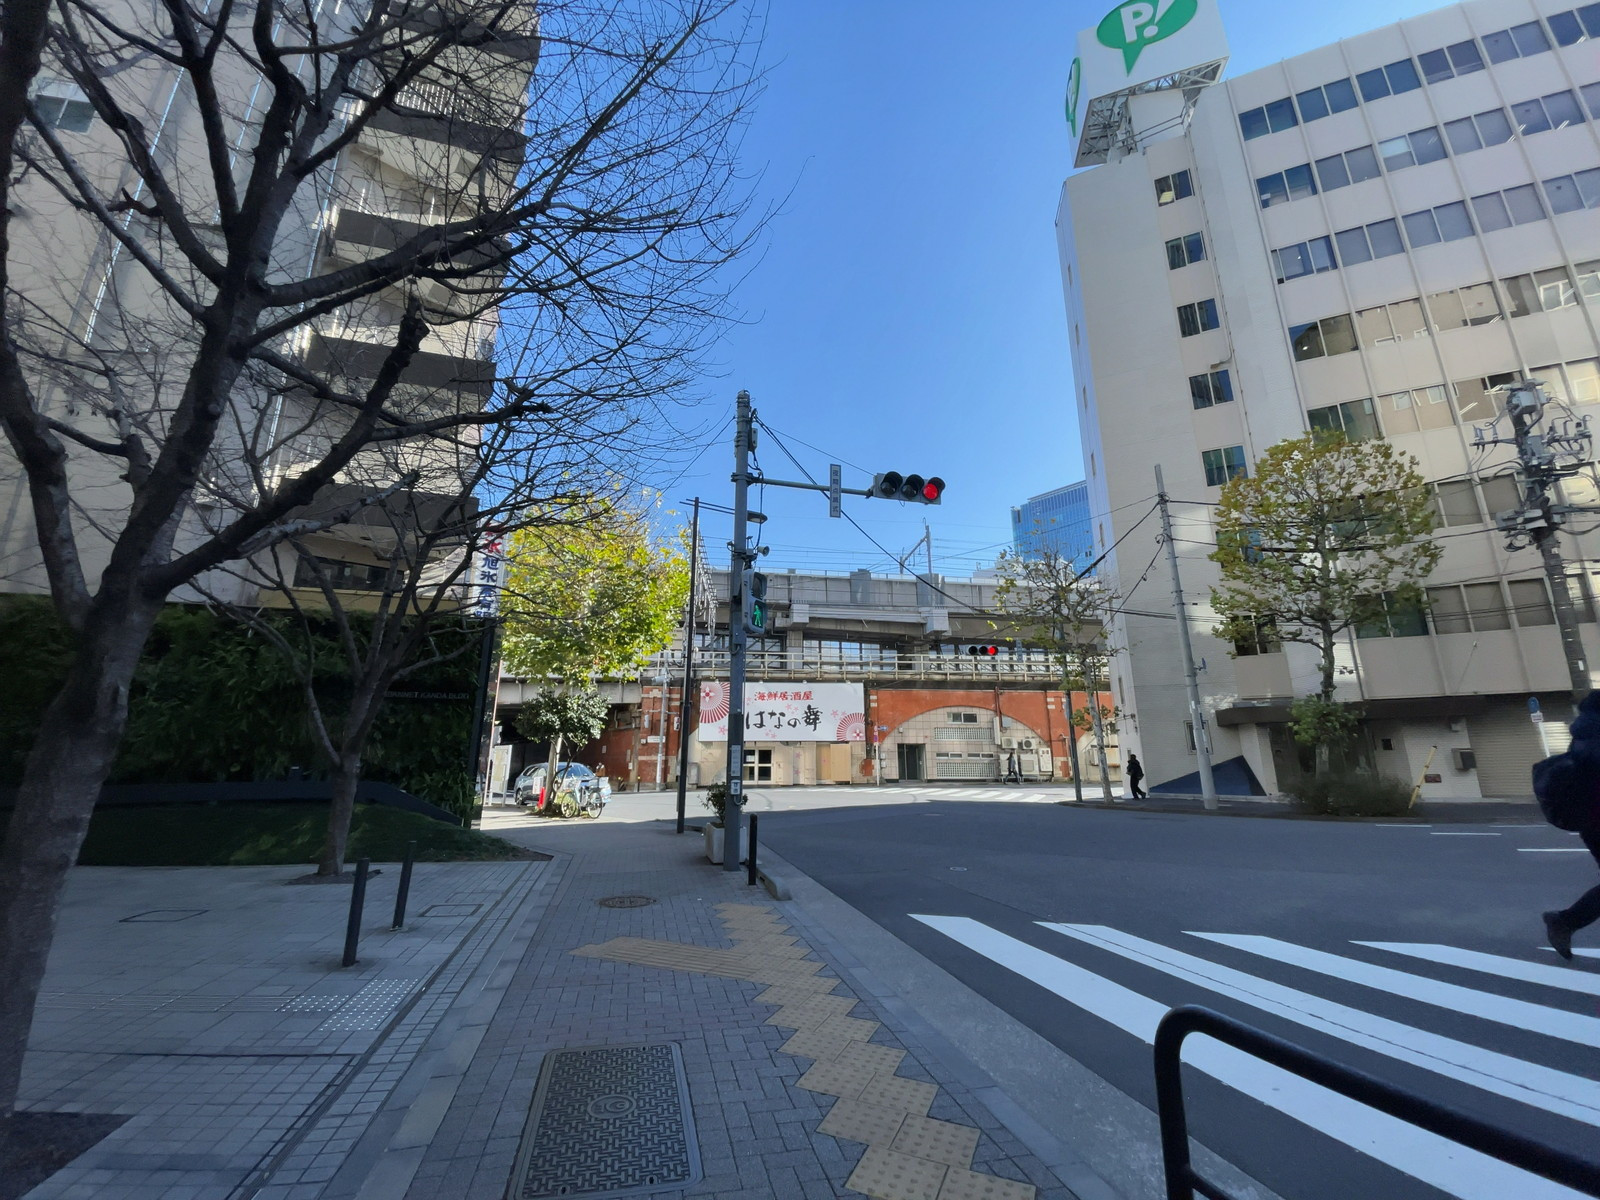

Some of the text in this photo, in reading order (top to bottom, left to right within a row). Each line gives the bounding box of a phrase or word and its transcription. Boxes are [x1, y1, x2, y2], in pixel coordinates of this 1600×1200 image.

[754, 690, 814, 701] 海鮮居酒屋
[745, 704, 823, 732] はなの舞
